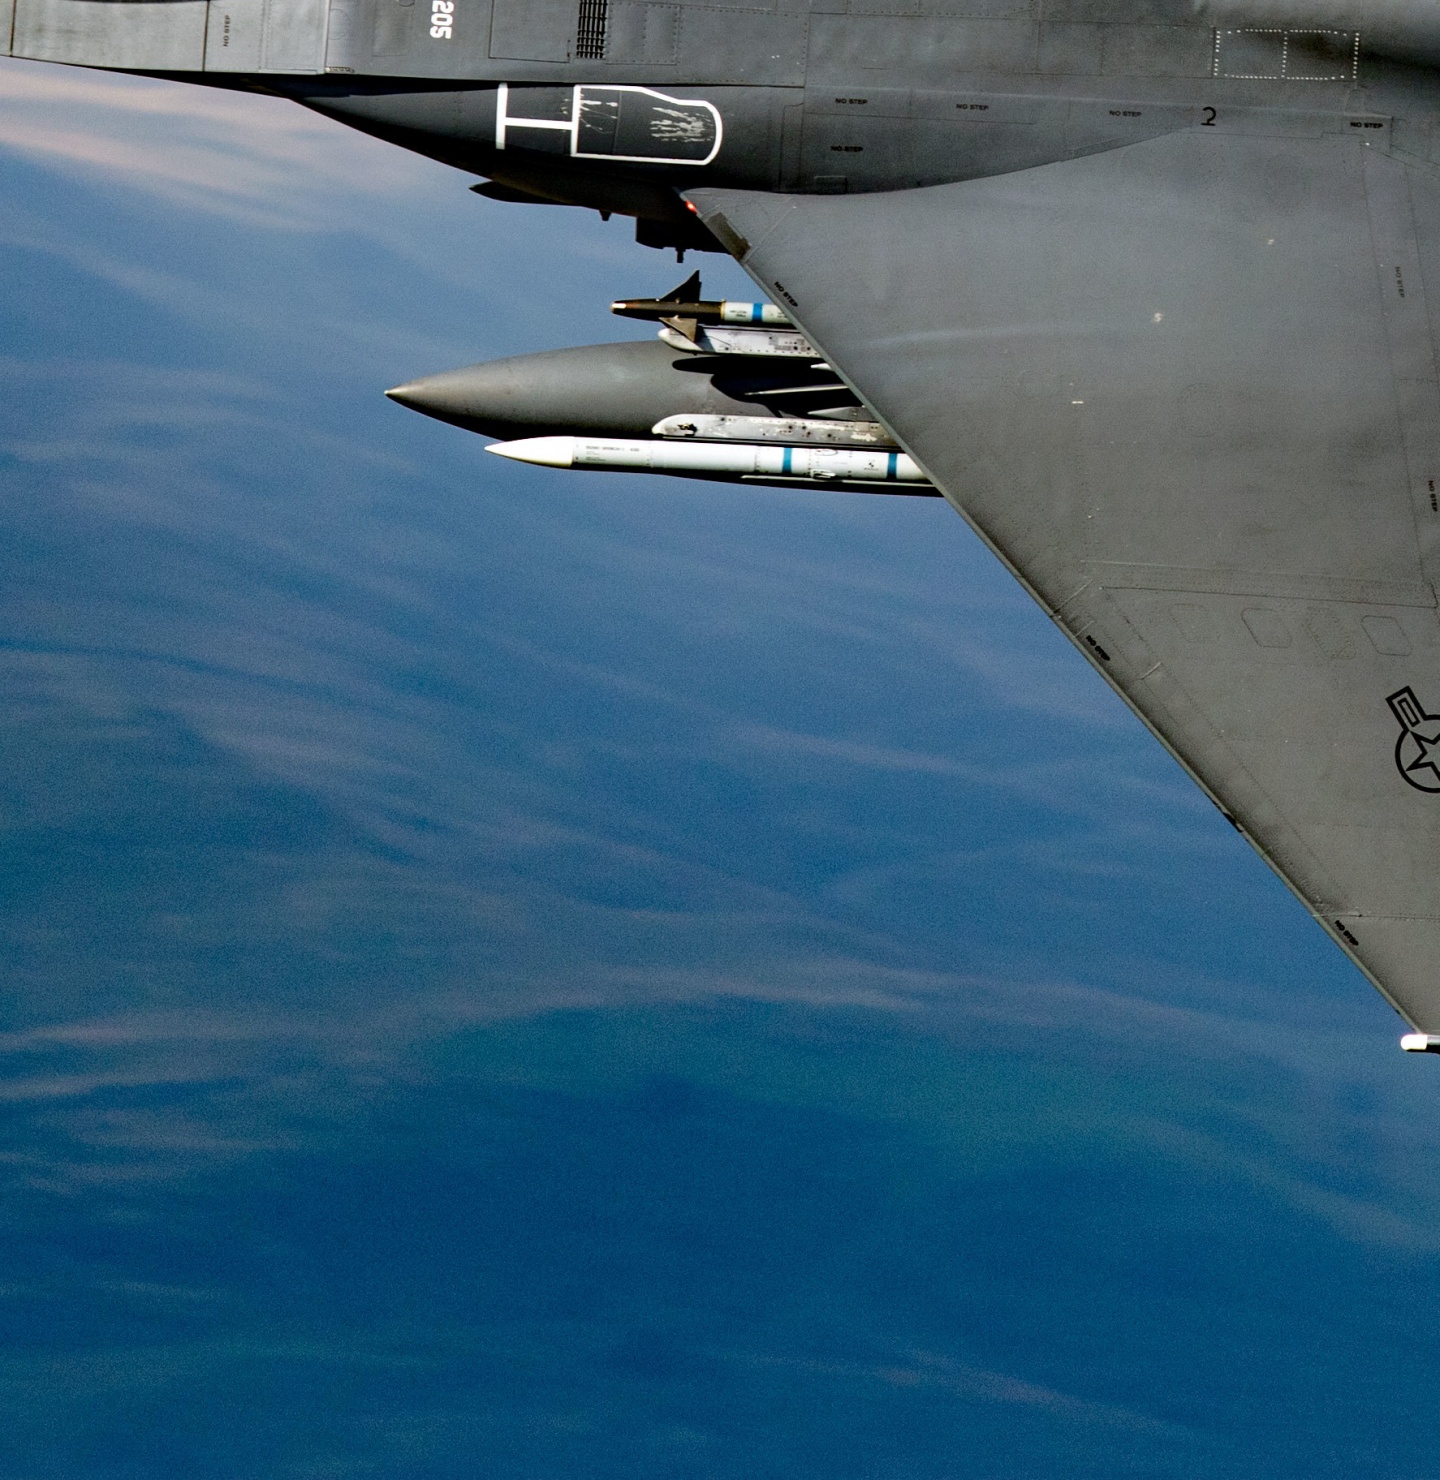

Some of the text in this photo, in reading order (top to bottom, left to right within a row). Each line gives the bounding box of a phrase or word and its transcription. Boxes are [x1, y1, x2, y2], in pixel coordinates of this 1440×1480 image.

[223, 35, 229, 47] NO
[774, 281, 784, 292] NO
[1395, 266, 1405, 298] NO STEP
[1428, 480, 1435, 491] NO
[1335, 920, 1345, 931] NO
